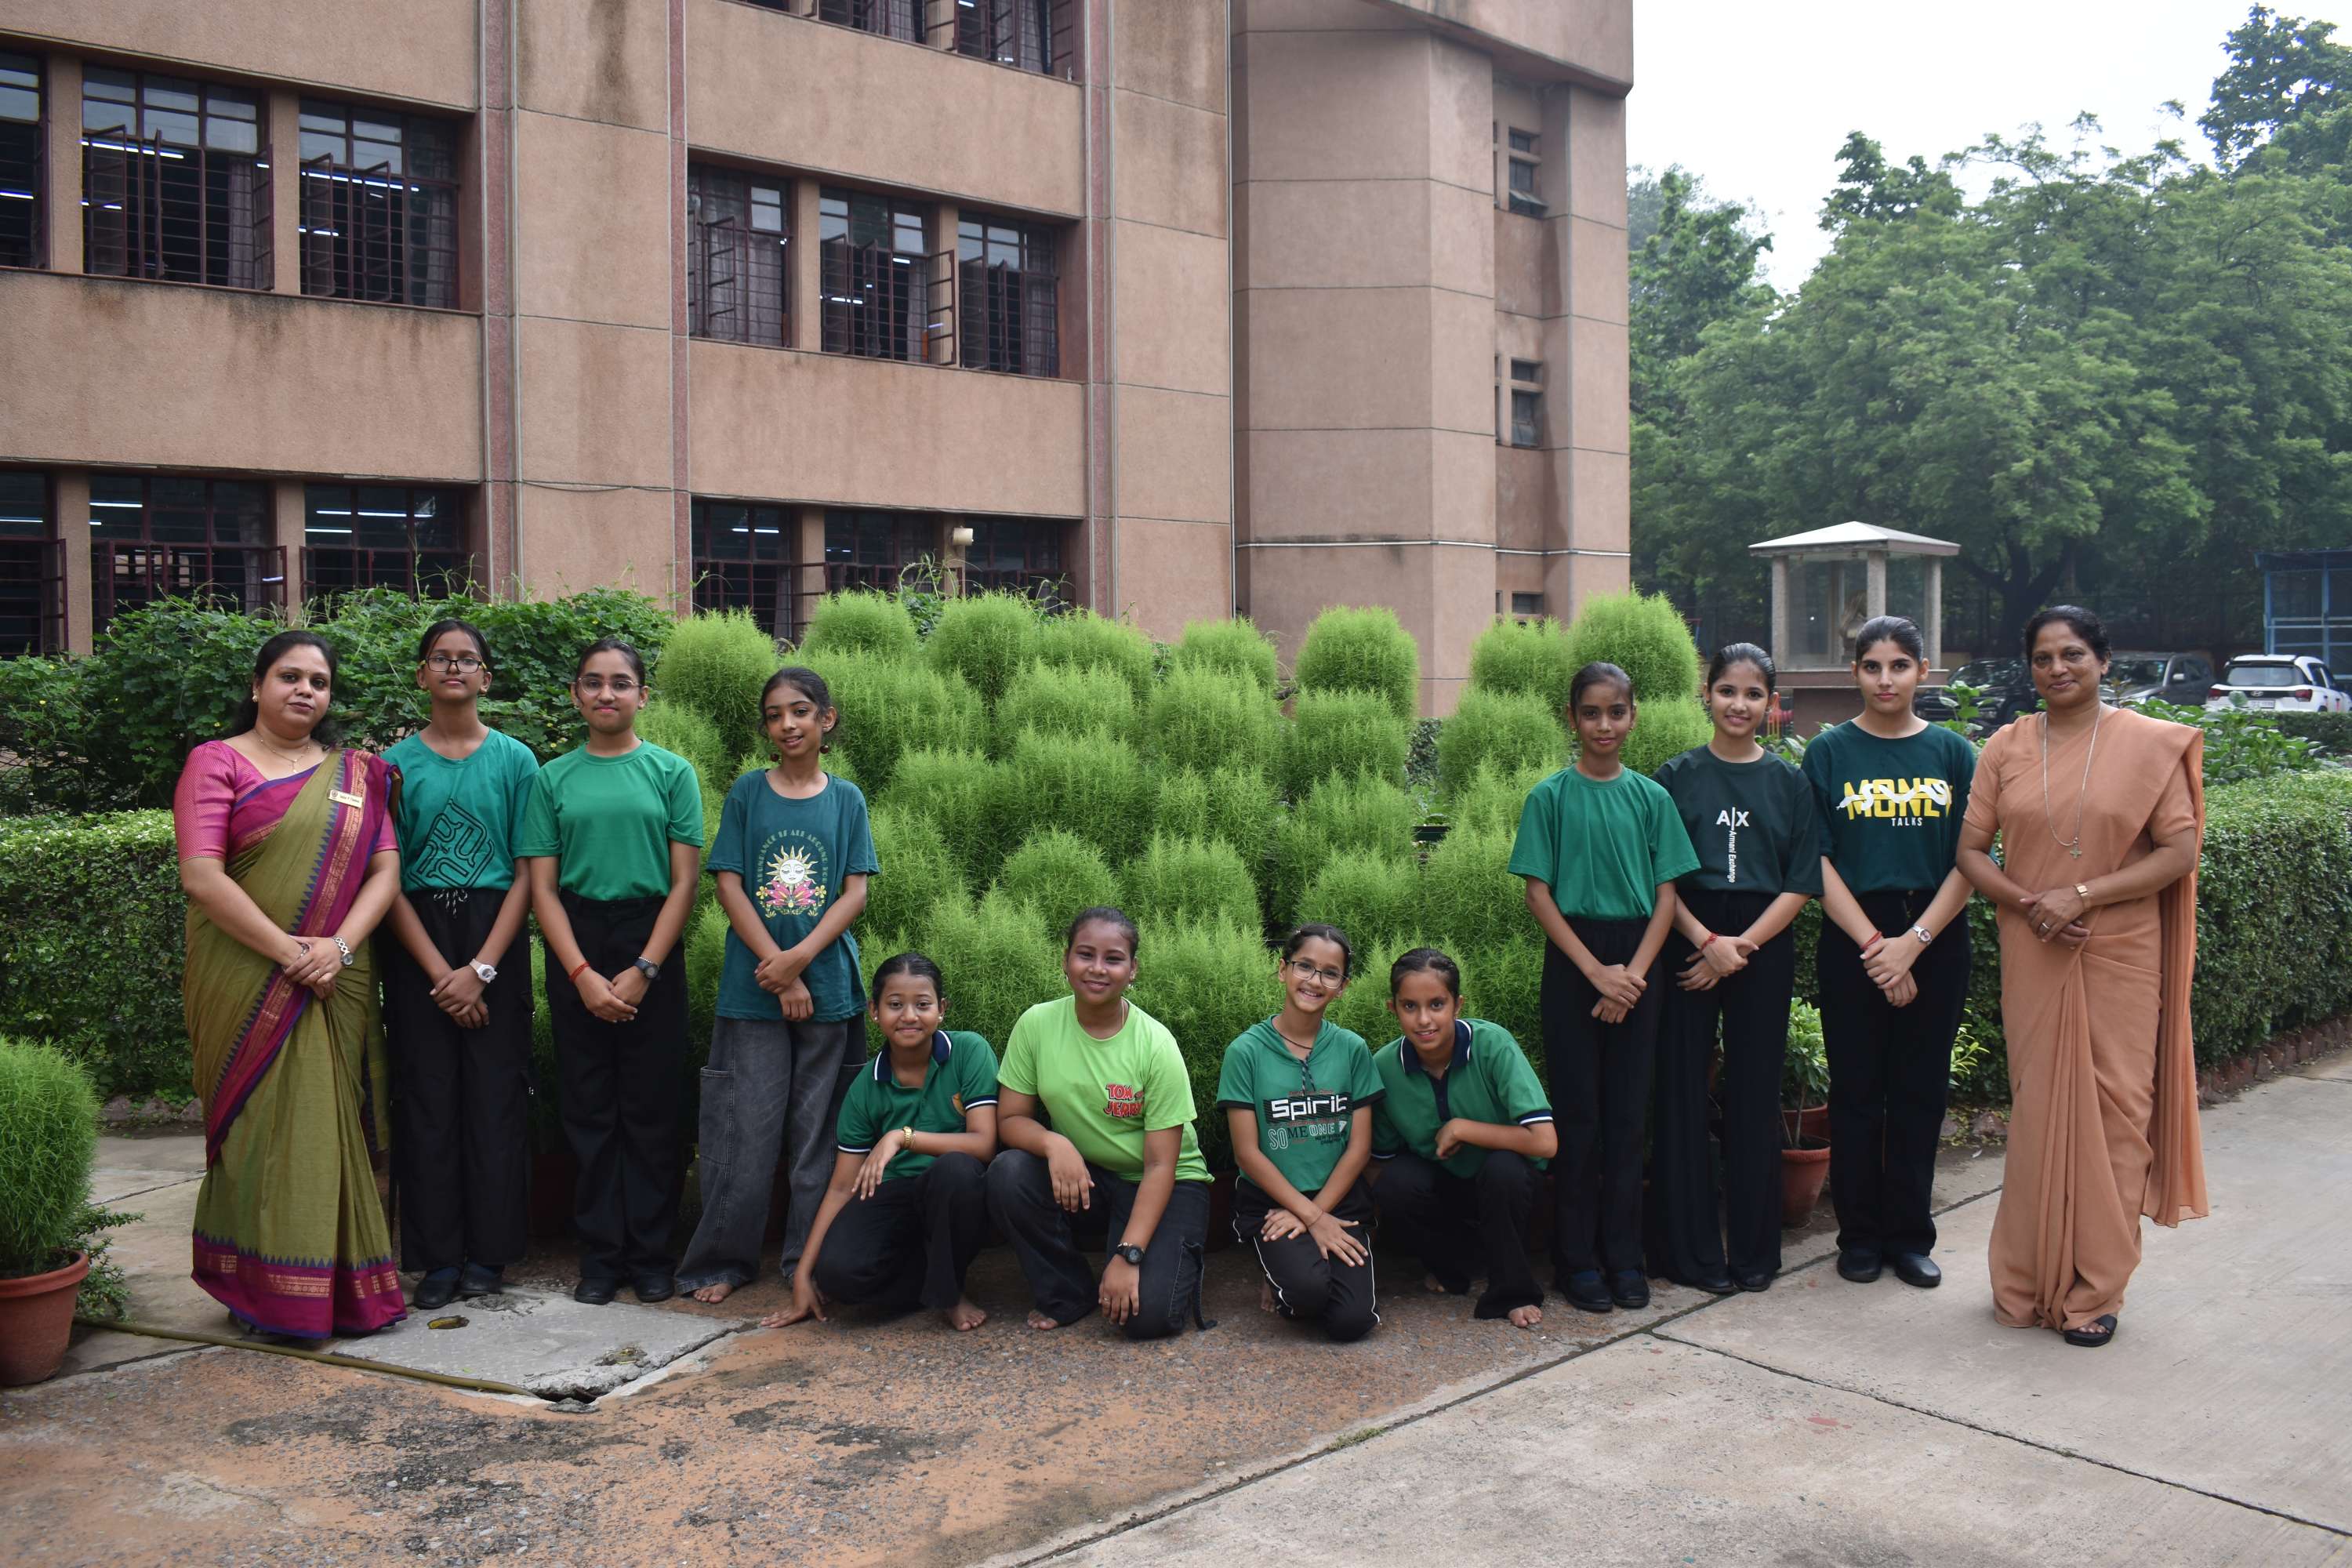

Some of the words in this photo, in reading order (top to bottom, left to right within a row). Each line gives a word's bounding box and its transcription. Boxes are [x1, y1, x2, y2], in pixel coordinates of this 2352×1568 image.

[1892, 817, 1923, 826] TALKS
[1728, 830, 1737, 853] Armani
[1105, 1083, 1134, 1101] TOM
